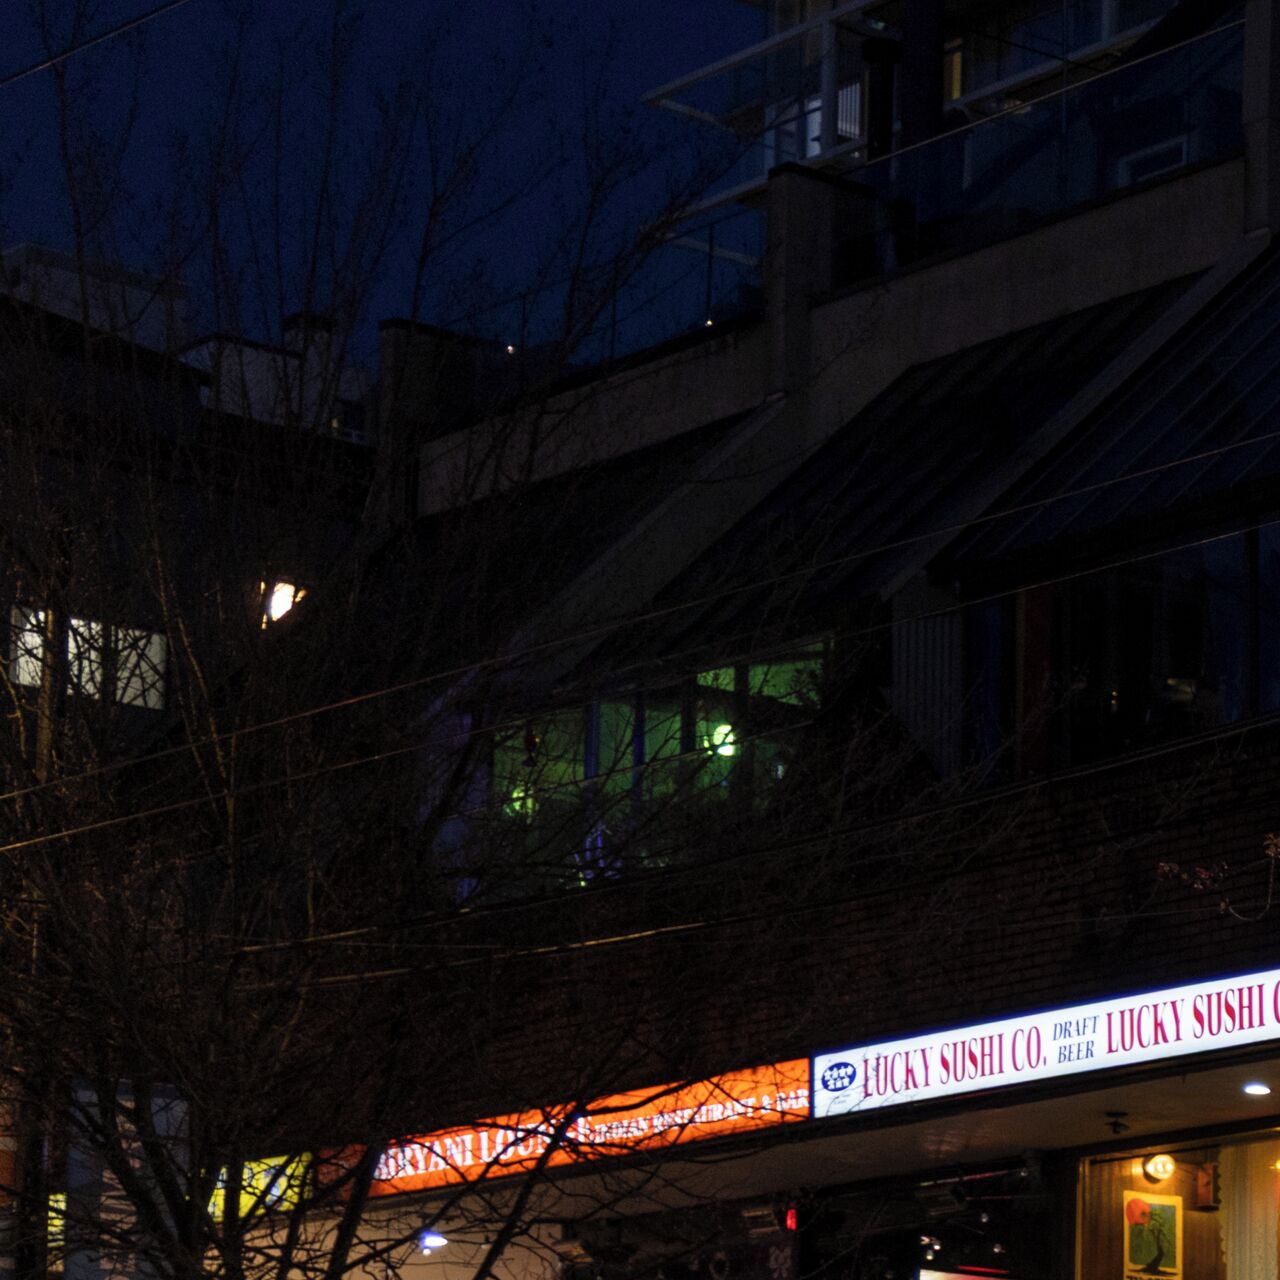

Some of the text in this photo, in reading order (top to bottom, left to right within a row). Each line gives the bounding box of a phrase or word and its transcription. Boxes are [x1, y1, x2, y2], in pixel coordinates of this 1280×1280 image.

[1052, 1014, 1100, 1042] DRAFT
[1105, 997, 1185, 1055] LUCKY
[1192, 983, 1266, 1039] SUSHI
[862, 1024, 1048, 1099] LUCKY SUSHI CO.
[1057, 1038, 1096, 1065] BEER
